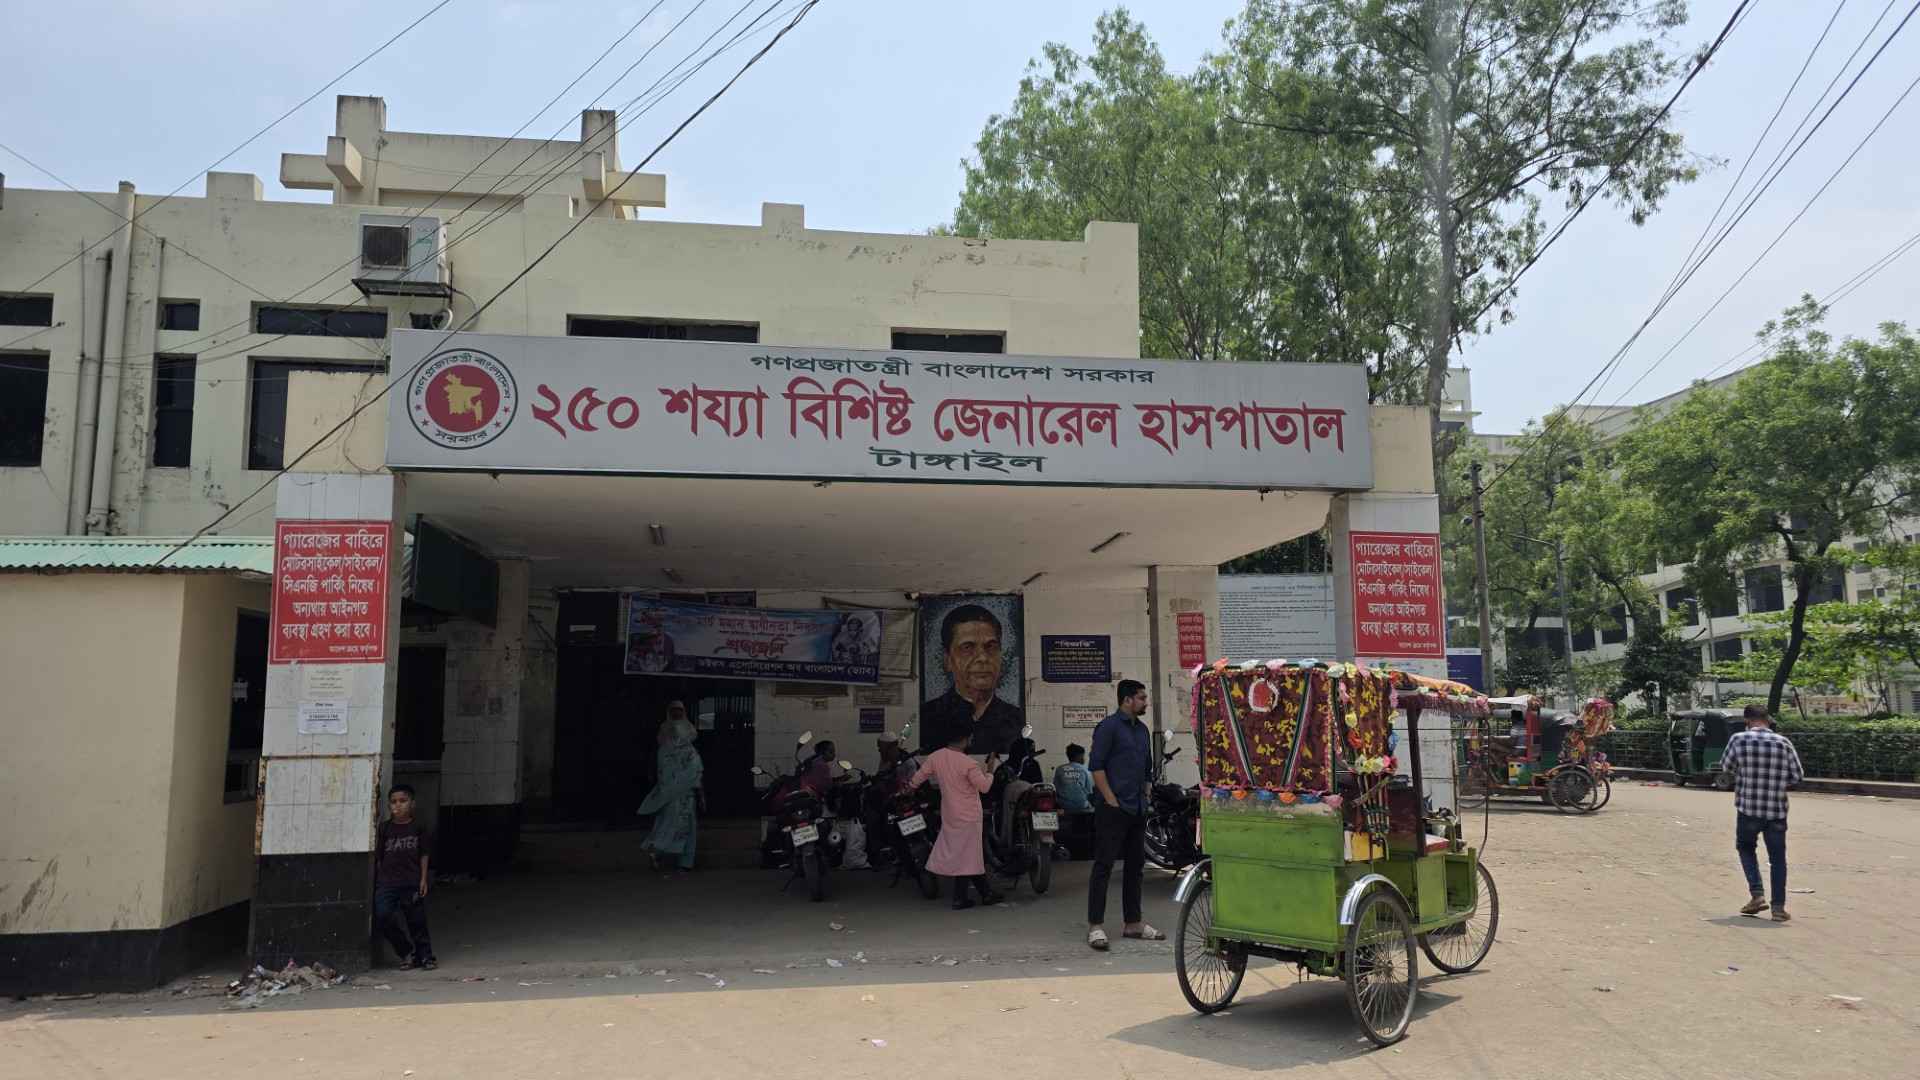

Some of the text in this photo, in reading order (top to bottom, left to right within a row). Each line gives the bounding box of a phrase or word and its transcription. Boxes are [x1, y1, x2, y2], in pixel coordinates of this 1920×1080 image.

[751, 354, 1155, 385] গণপ্রজাতন্ত্রী বাংলাদেশ সরকার
[531, 375, 1347, 455] ২৫০ শয্যা বিশিষ্ট জেনারেল হাসপাতাল
[869, 445, 1047, 474] টাঙ্গাইল
[283, 528, 384, 549] গ্যারেজের বাহিরে
[1355, 540, 1433, 558] গ্যারেজের বাহিরে
[282, 574, 319, 594] সিএনজি
[329, 598, 369, 618] আইনগত
[334, 622, 352, 638] করা
